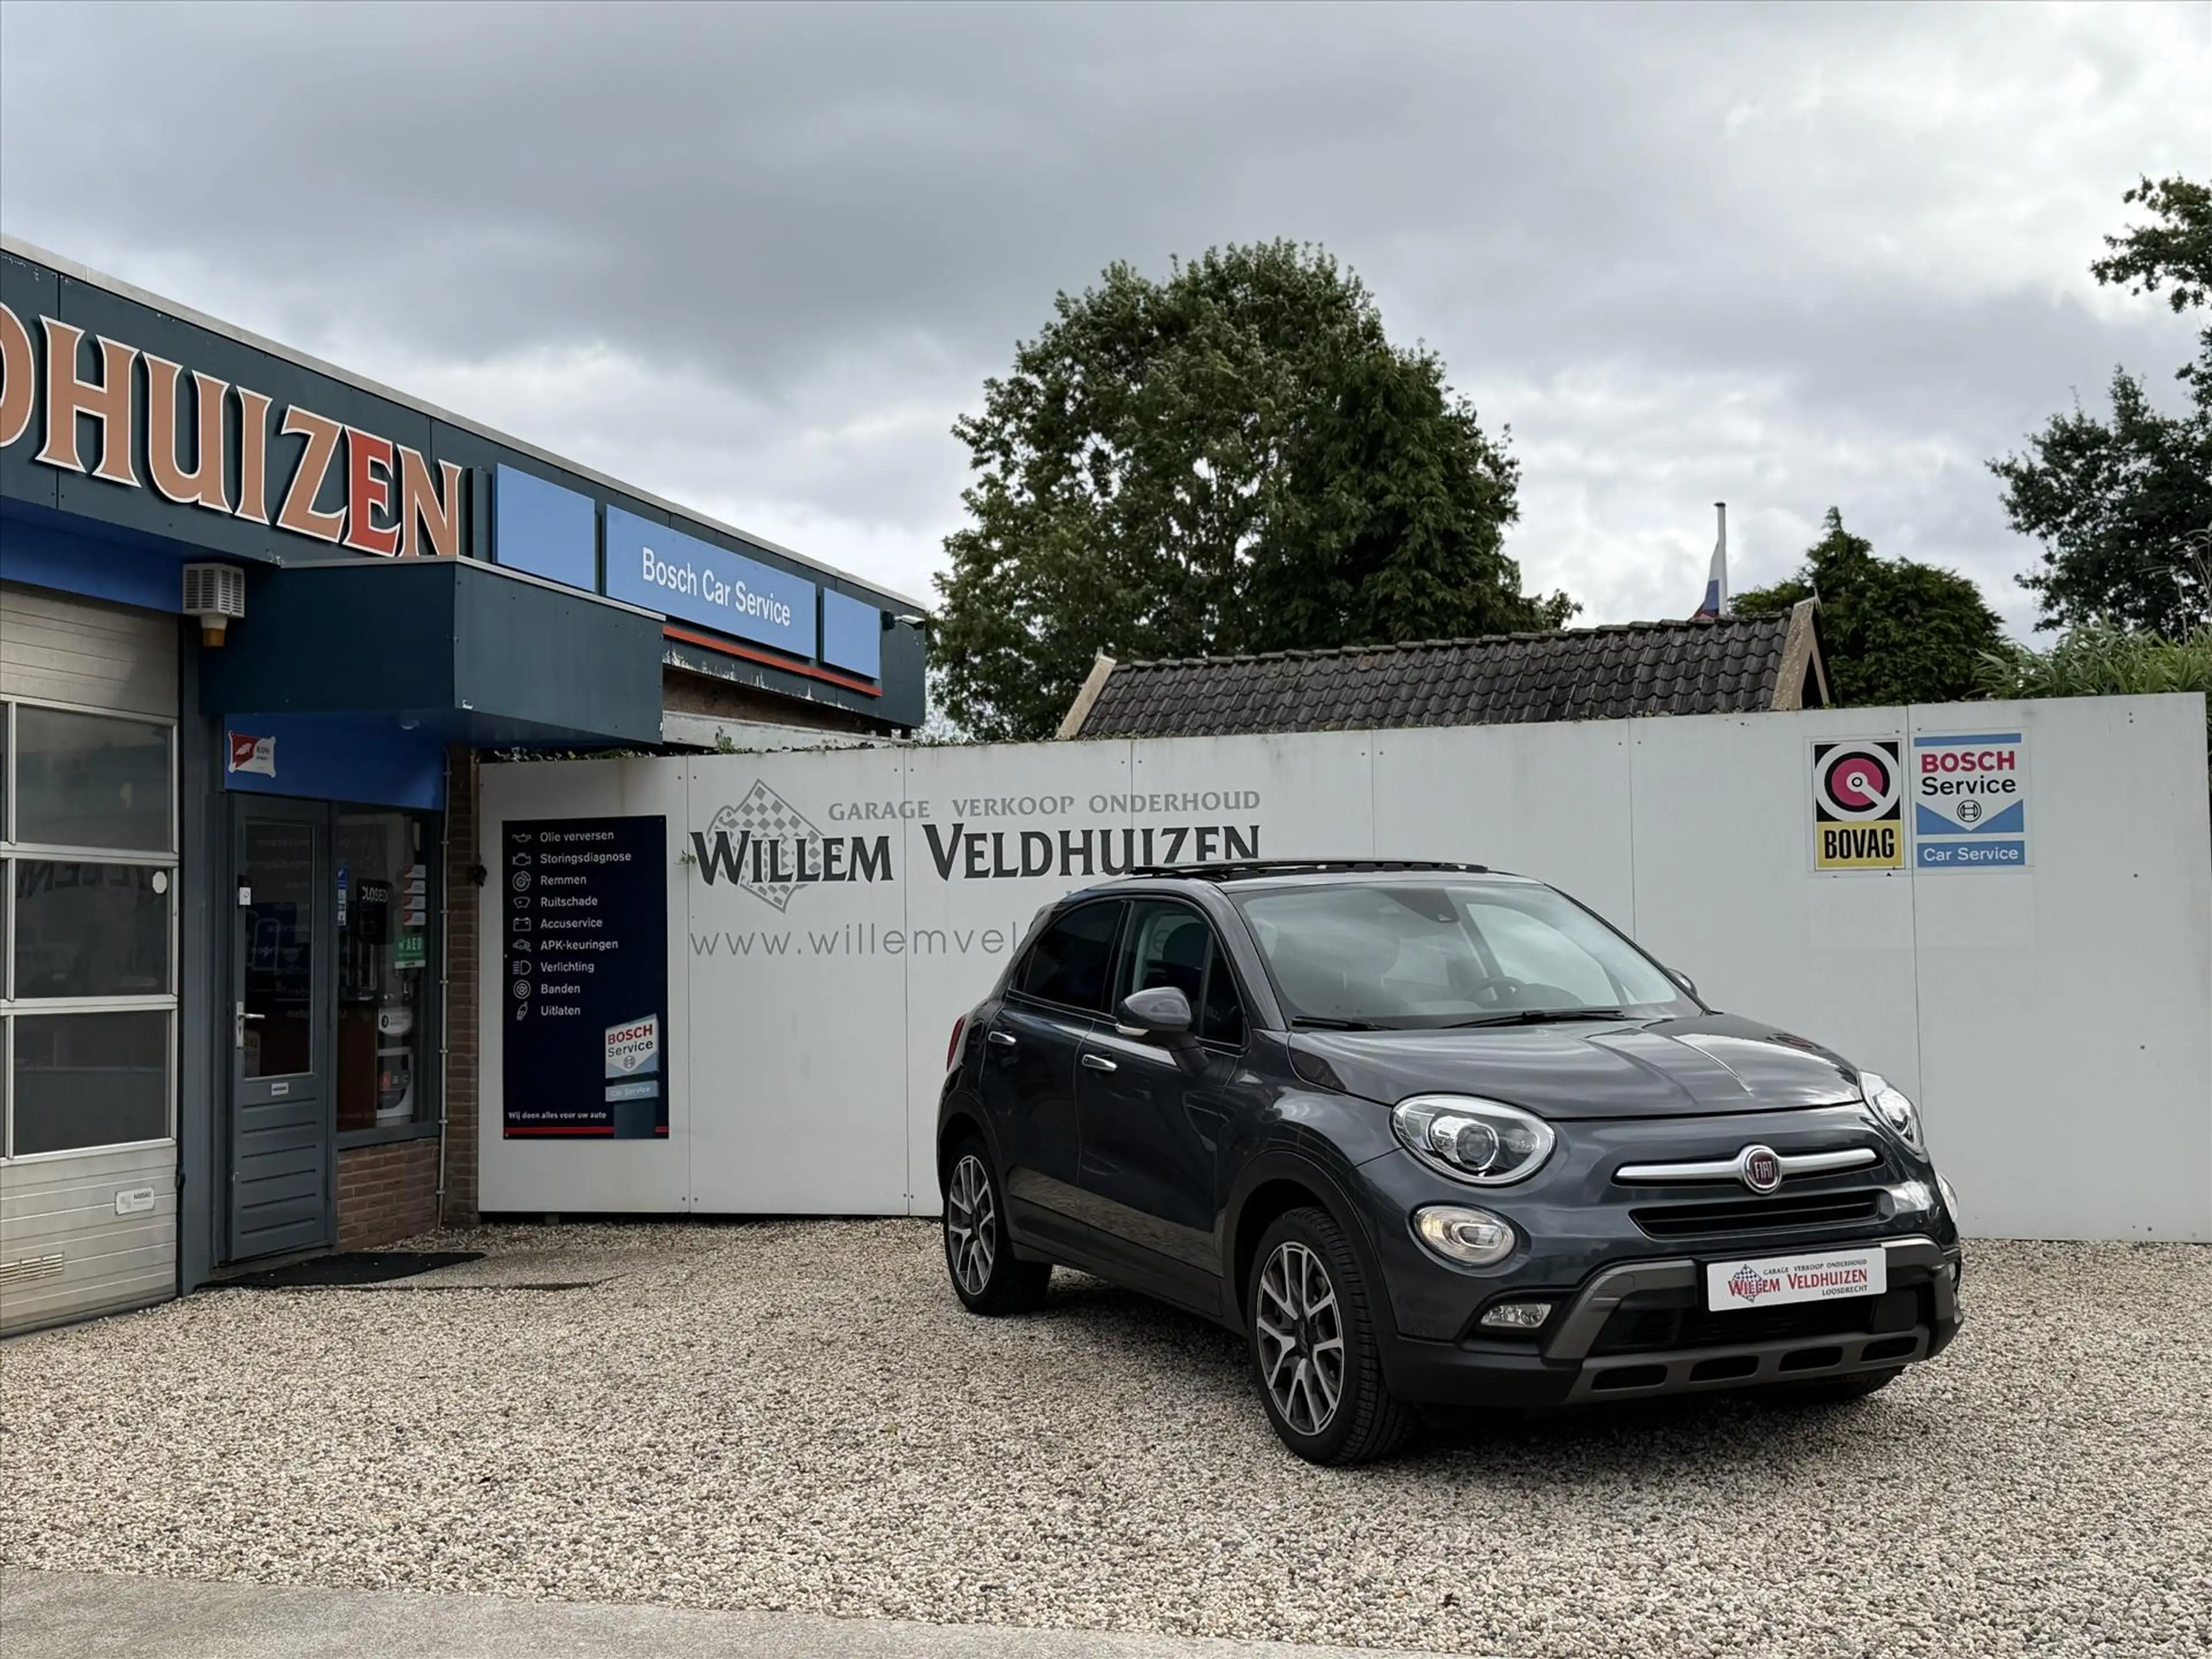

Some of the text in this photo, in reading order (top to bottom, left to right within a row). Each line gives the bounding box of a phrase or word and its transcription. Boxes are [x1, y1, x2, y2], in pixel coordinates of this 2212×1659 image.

[642, 547, 791, 627] Bosch Car Service
[1921, 751, 2015, 774] BOSCH
[1921, 775, 2016, 796] Service
[828, 790, 1261, 821] GARAGE VERKOOP ONDERHOUD
[540, 831, 615, 842] Olie verversen
[1824, 828, 1895, 859] BOVAG
[540, 852, 632, 865] Storingsdiagnose
[689, 822, 1261, 886] WILLEM VELDHUIZEN
[1923, 846, 2018, 862] Car Service
[540, 875, 587, 885] Remmen
[540, 896, 598, 907] Ruitschade
[540, 917, 603, 929] Accuservice
[540, 940, 619, 951] APK-keuringen
[690, 922, 1017, 956] www.willemvel
[540, 961, 595, 974] Verlichting
[540, 983, 581, 994] Banden
[540, 1005, 581, 1016] Uitlaten
[608, 1024, 653, 1046] BOSCH
[607, 1039, 654, 1058] Service
[508, 1112, 521, 1120] Wij
[1754, 1161, 1773, 1179] FIAT
[1763, 1267, 1789, 1275] GARAGE
[1793, 1263, 1824, 1272] VERKOOP
[1728, 1268, 1868, 1297] WILLEM VELDHUIZEN
[1822, 1285, 1868, 1296] LOOSDRECHT
